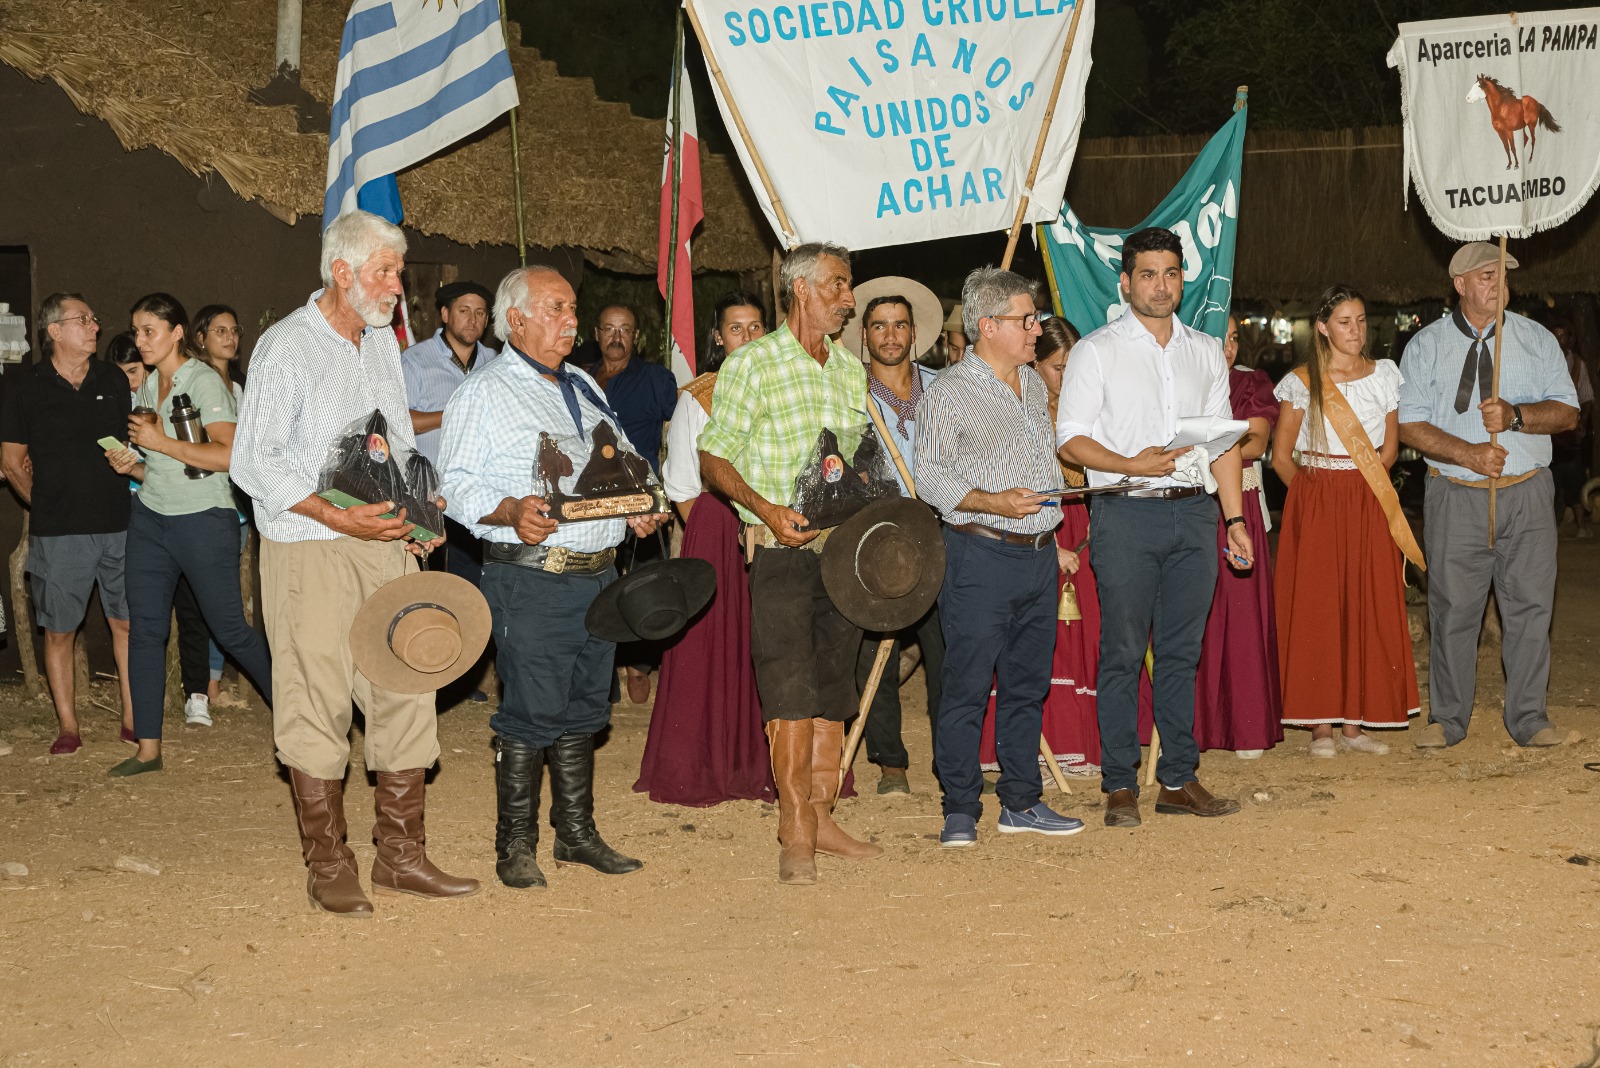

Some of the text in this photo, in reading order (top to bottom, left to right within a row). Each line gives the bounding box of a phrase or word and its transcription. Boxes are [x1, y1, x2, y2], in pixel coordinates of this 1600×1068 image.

[724, 0, 905, 46] SOCIEDAD
[1418, 24, 1598, 67] Aparceria LA PAMPA
[815, 33, 1035, 136] PAISANOS
[862, 90, 991, 139] UNIDOS
[910, 133, 955, 172] DE
[876, 167, 1006, 219] ACHAR
